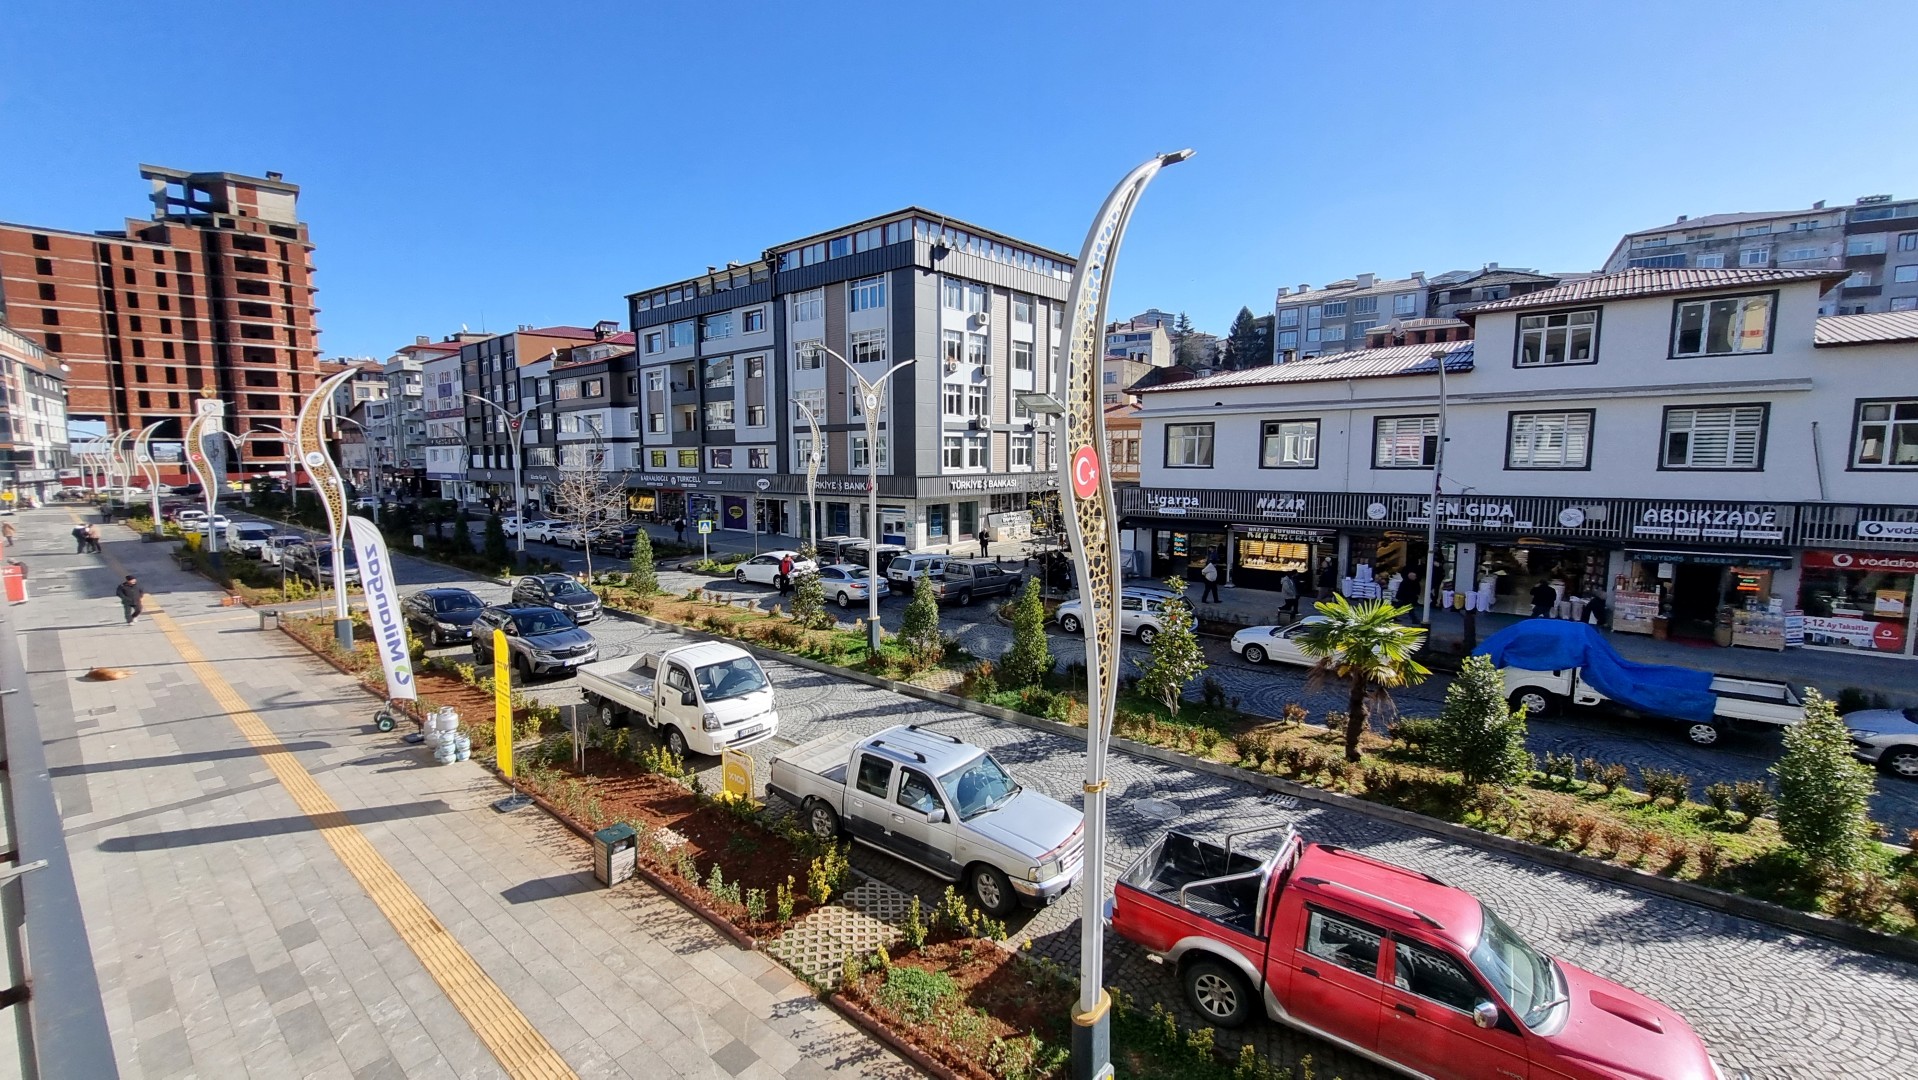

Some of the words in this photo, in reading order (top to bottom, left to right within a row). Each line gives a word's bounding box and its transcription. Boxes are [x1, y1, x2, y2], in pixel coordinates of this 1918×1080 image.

[951, 479, 982, 490] TÜRKİYE
[988, 479, 1017, 488] BANKASI
[1147, 493, 1199, 508] Ligarpa
[1256, 497, 1307, 511] NAZAR
[1465, 503, 1514, 518] GIDA
